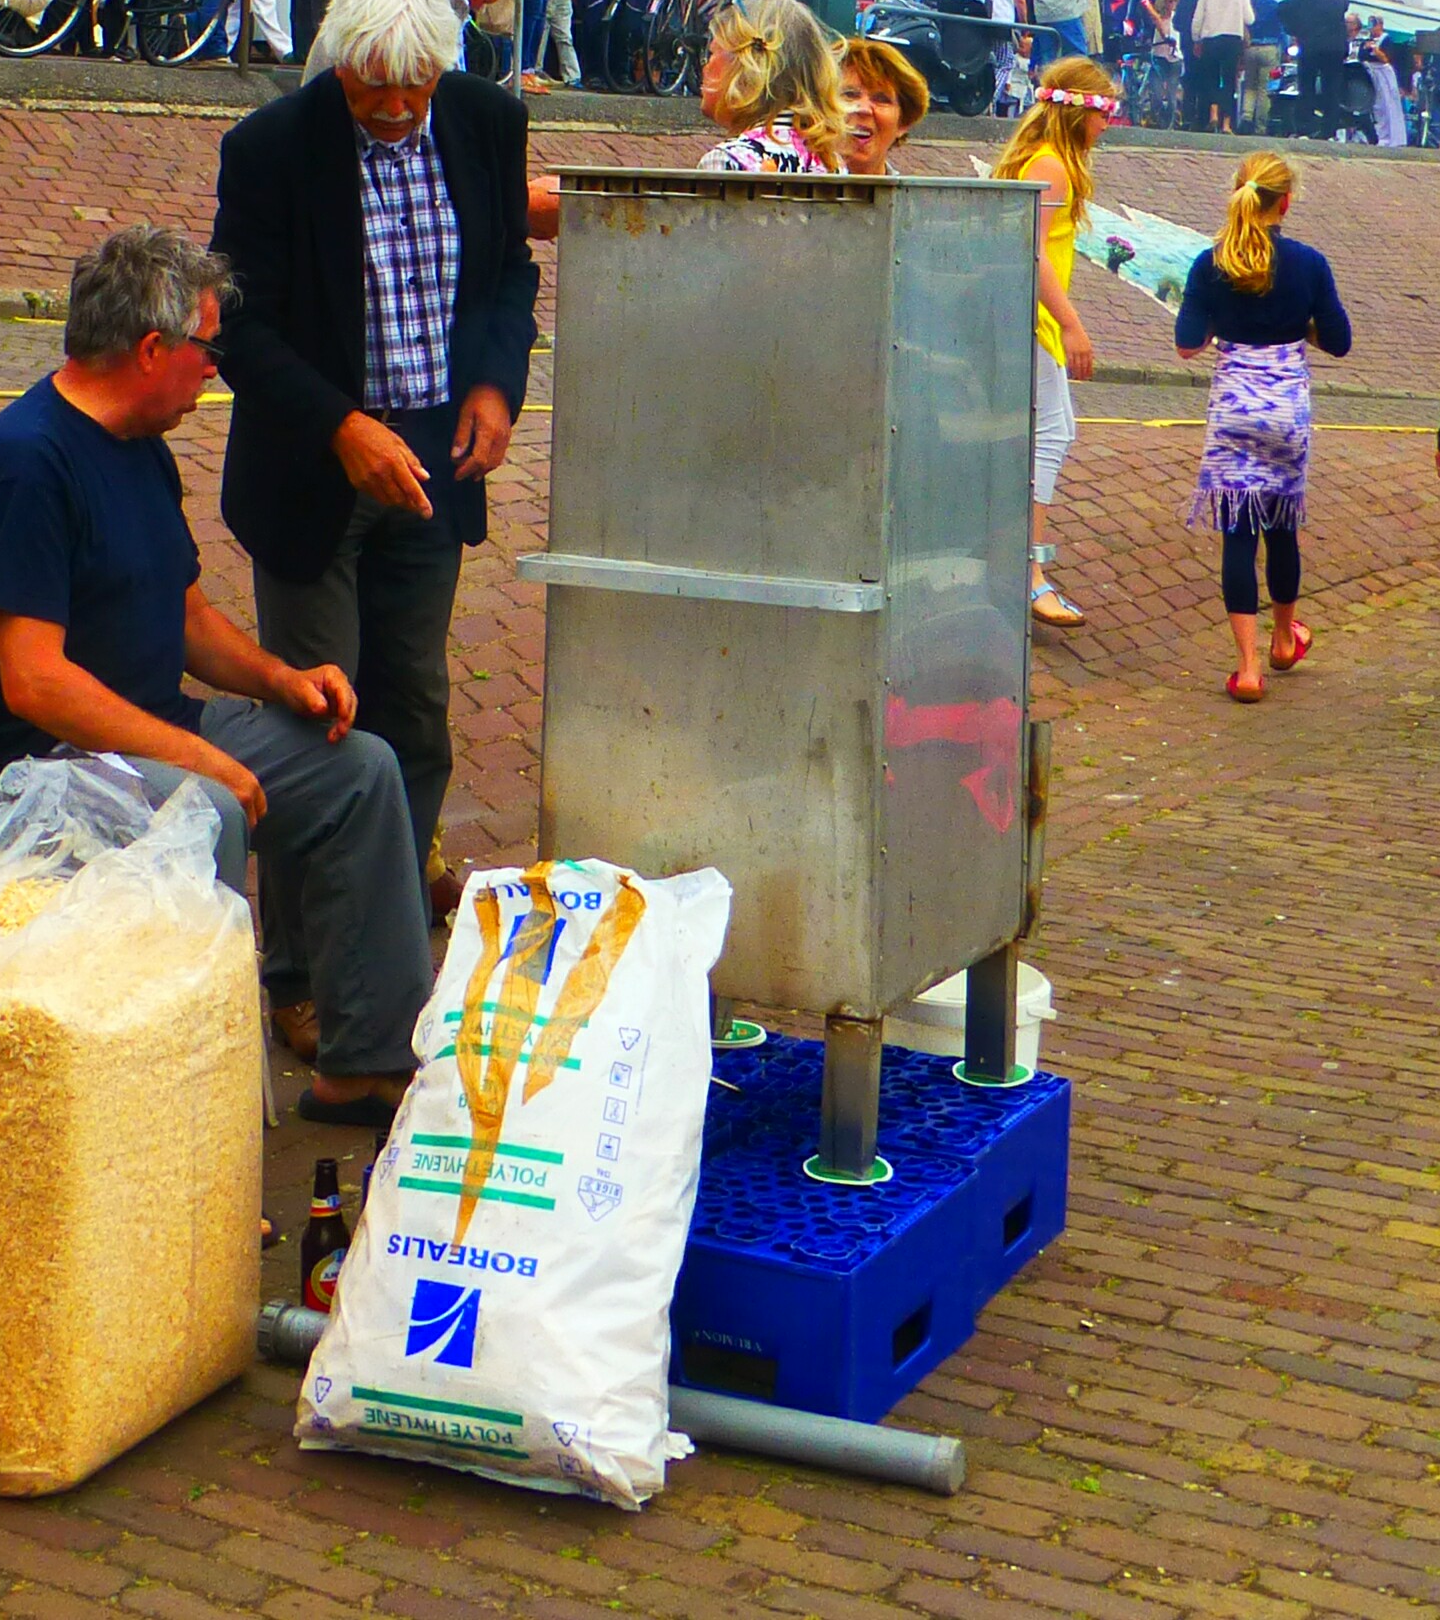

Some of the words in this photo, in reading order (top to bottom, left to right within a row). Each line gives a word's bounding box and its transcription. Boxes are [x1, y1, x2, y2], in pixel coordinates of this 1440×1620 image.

[410, 1152, 548, 1188] POLYETHYLENE
[386, 1233, 539, 1278] BOREALIS
[363, 1407, 514, 1446] POLYETHYLENE
